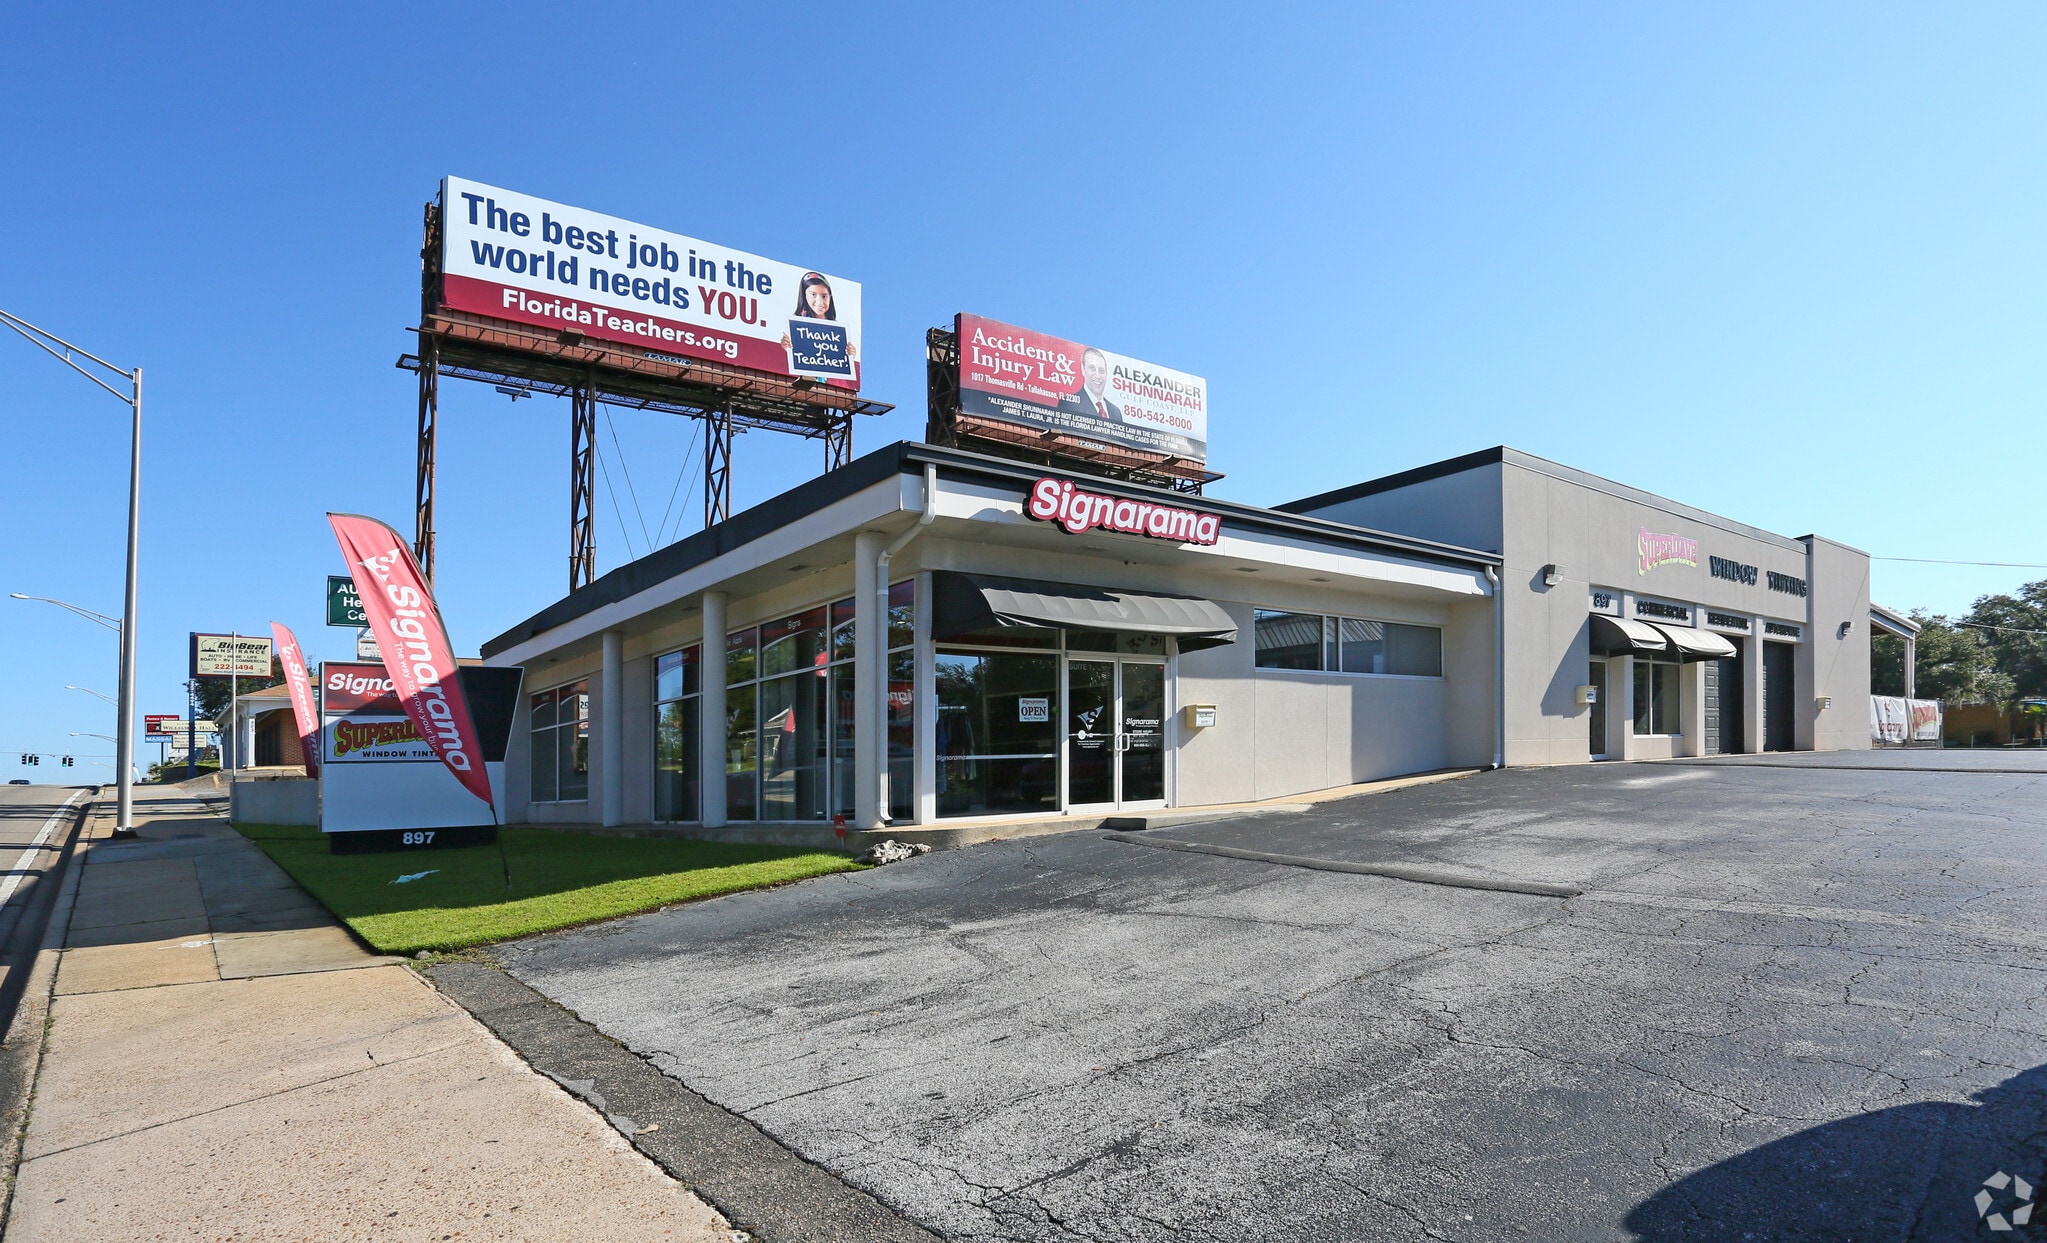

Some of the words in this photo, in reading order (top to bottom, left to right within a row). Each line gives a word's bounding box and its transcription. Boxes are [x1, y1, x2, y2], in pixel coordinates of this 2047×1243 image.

[461, 192, 531, 237] The
[542, 213, 618, 259] best
[626, 234, 679, 273] job
[689, 249, 716, 282] in
[725, 260, 773, 295] the
[470, 239, 578, 285] world
[590, 268, 689, 310] needs
[697, 285, 767, 327] YOU.
[502, 288, 738, 359] FloridaTeachers.org
[797, 326, 841, 343] Thank
[648, 353, 687, 366] LAMAR
[794, 352, 849, 370] Teacher!
[813, 340, 839, 356] you
[971, 346, 1034, 381] Injury
[1037, 363, 1076, 387] Law
[1112, 364, 1201, 399] ALEXANDER
[971, 372, 984, 382] 1017
[985, 374, 1016, 389] Thomasville
[1016, 381, 1025, 391] Rd
[1059, 391, 1065, 400] FL
[1112, 377, 1202, 412] SHUNNARAH
[1002, 406, 1021, 416] JAMES
[1060, 419, 1070, 427] THE
[1071, 420, 1091, 431] FLORIDA
[1091, 425, 1111, 435] LAWYER
[1110, 429, 1135, 440] HANDLING
[1135, 435, 1149, 444] CASES
[1150, 438, 1159, 446] FOR
[1023, 404, 1055, 418] SHUNNARAH
[1061, 412, 1072, 420] NOT
[1072, 414, 1096, 425] LICENSED
[1096, 419, 1103, 427] TO
[1103, 421, 1125, 432] PRACTICE
[1125, 426, 1136, 435] LAW
[1151, 432, 1165, 440] STATE
[1123, 404, 1192, 431] 850-542-8000
[1032, 479, 1218, 542] Signarama
[1709, 555, 1759, 587] WINDOW
[1766, 570, 1807, 598] TINTING
[1593, 592, 1612, 609] 897
[1637, 600, 1689, 620] COMMERCIAL
[328, 672, 396, 695] Signa
[387, 584, 472, 772] Signarama
[394, 641, 405, 660] The
[400, 659, 412, 679] way
[407, 680, 416, 691] to
[418, 713, 433, 736] your
[1021, 706, 1047, 716] OPEN
[1126, 718, 1160, 727] Signarama
[402, 831, 436, 845] 897
